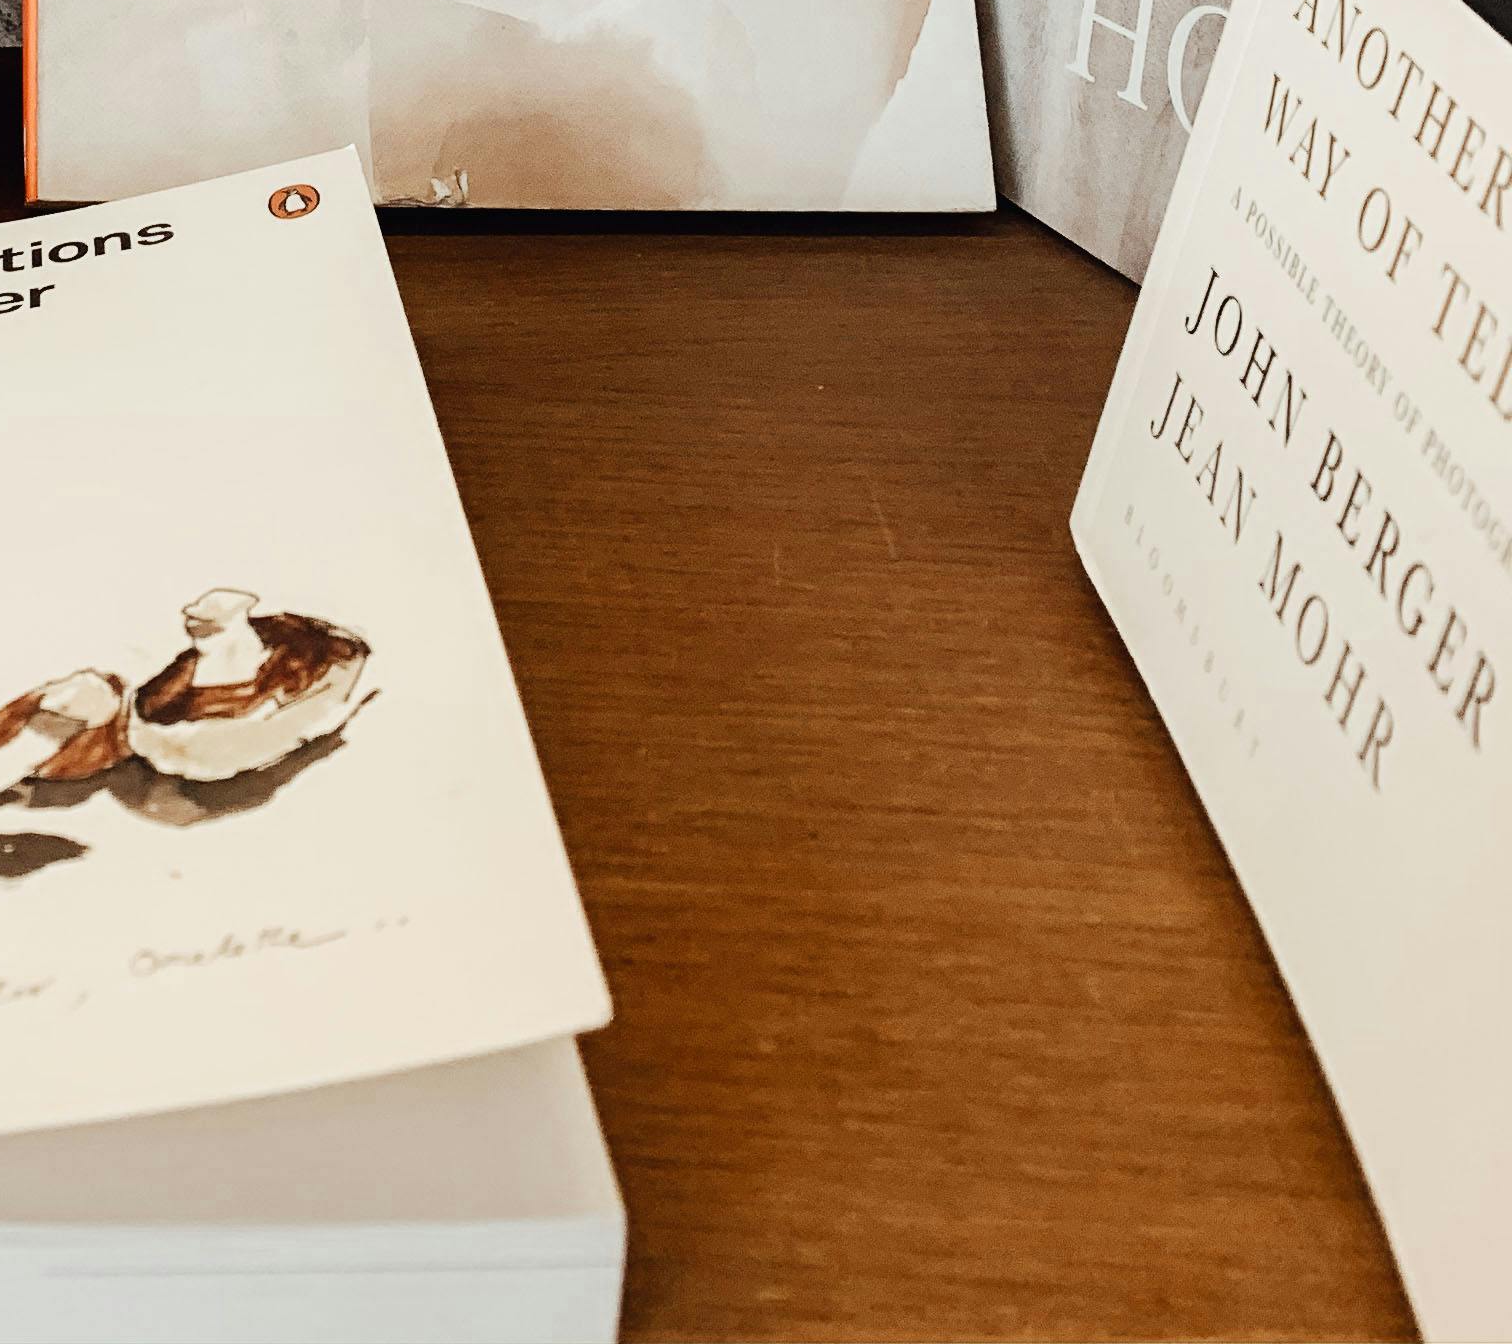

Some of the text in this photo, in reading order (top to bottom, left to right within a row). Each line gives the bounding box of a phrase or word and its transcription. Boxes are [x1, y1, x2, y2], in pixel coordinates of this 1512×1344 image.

[1230, 186, 1243, 213] A
[1245, 200, 1319, 305] POSSIBLE
[1321, 295, 1393, 396] THEORY
[1394, 391, 1423, 434] OF
[1264, 73, 1351, 200] WAY
[1358, 186, 1424, 283] OF
[1149, 371, 1396, 792] JEAN MOHR
[1184, 266, 1497, 753] JOHN BERGER
